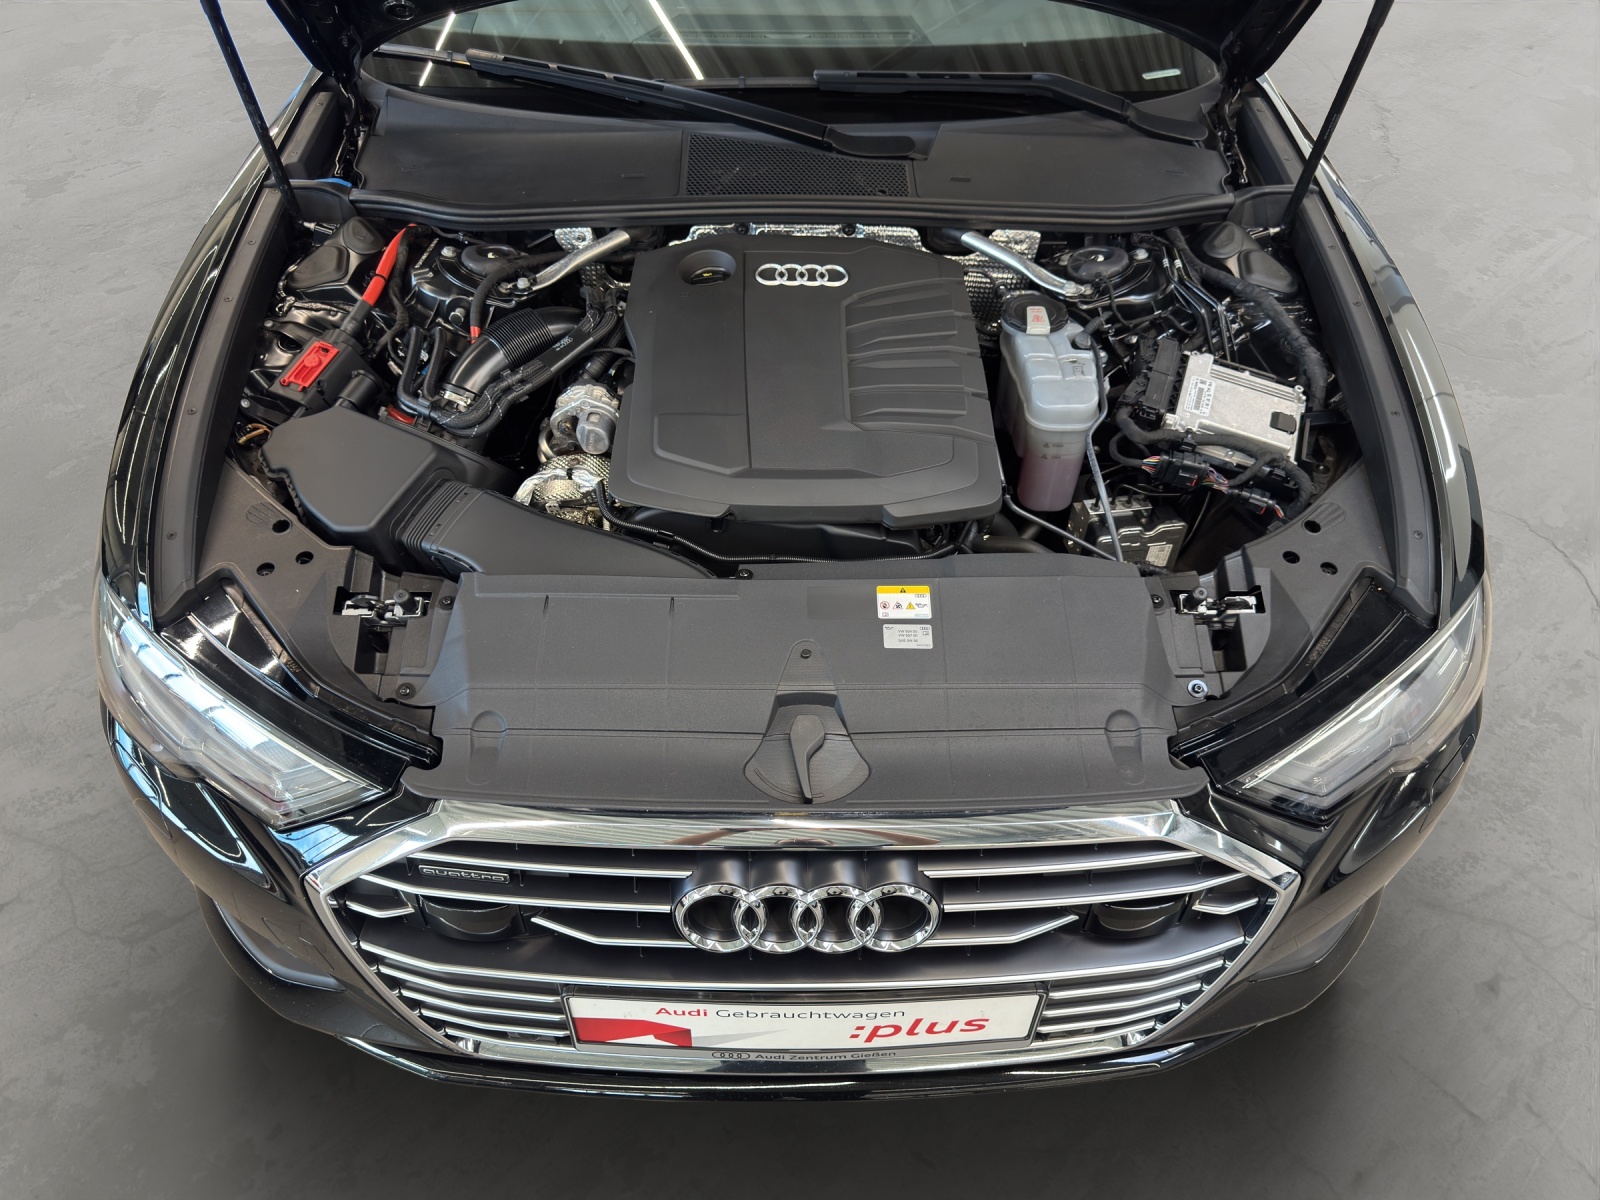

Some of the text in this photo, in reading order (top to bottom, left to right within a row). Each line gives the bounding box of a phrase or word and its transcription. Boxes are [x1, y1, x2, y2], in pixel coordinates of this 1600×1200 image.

[423, 868, 505, 881] quattro
[655, 1007, 905, 1020] Audi Gebrauchtwagen
[850, 1051, 896, 1059] Gießen
